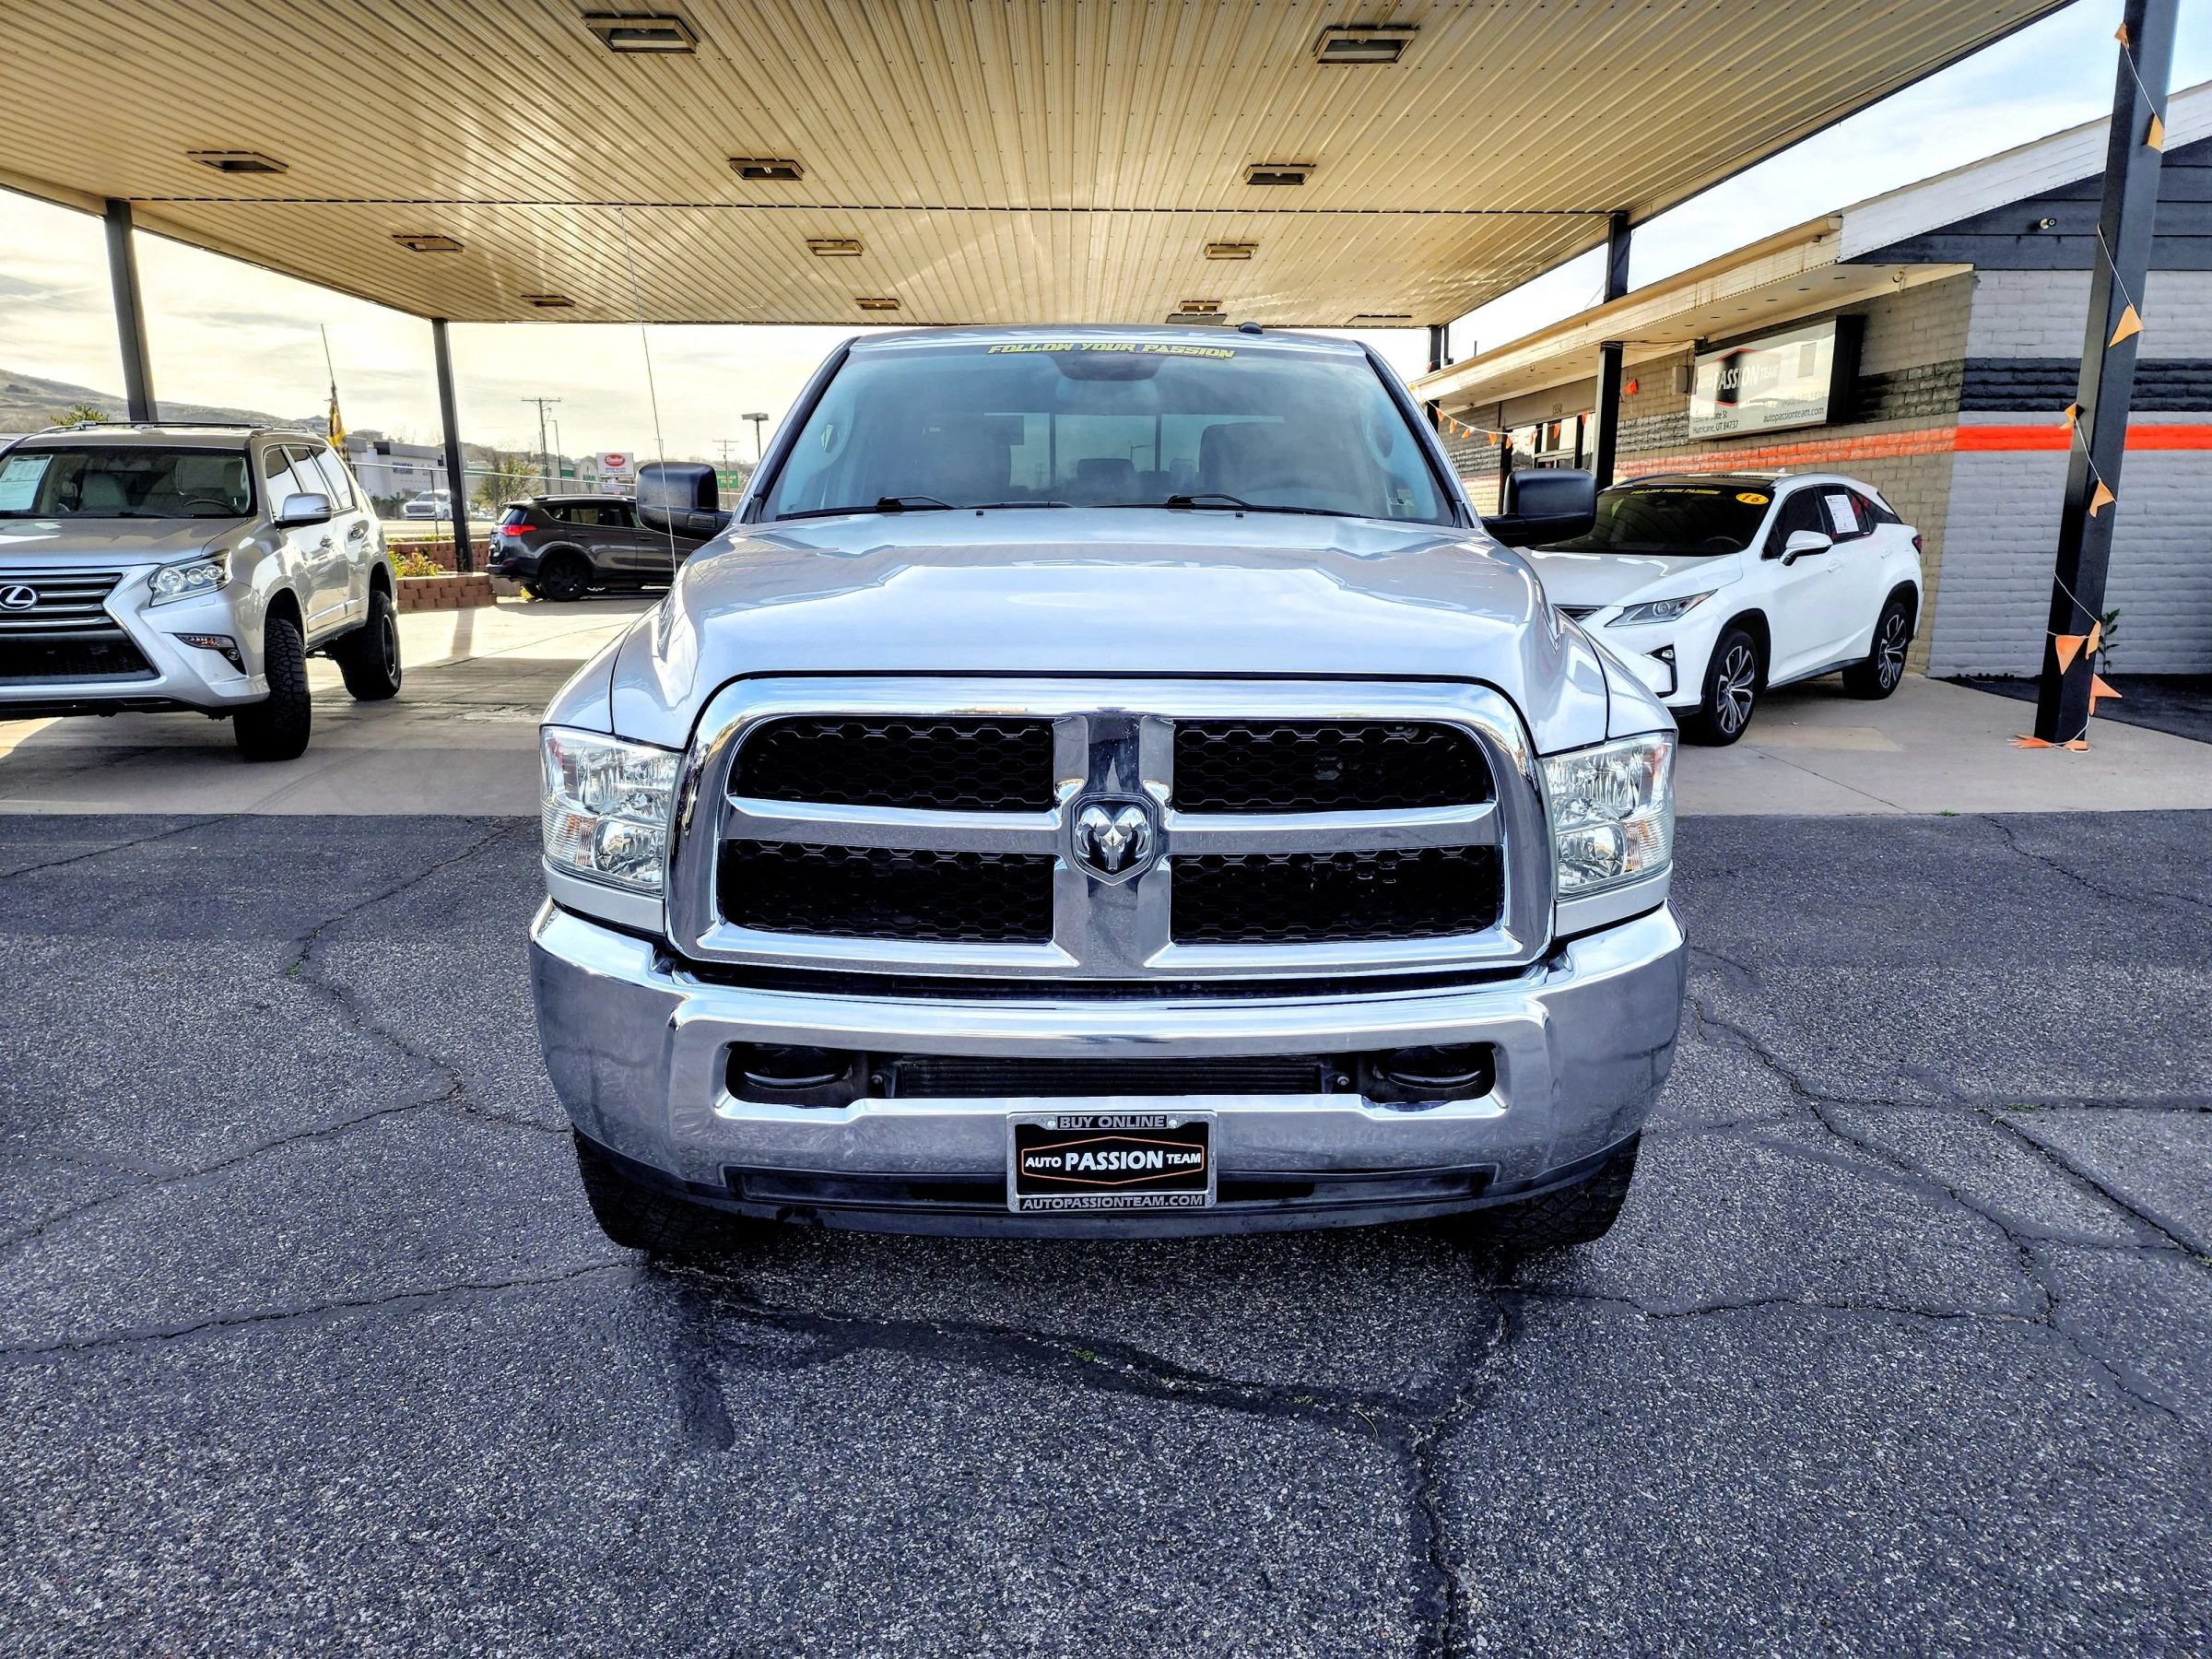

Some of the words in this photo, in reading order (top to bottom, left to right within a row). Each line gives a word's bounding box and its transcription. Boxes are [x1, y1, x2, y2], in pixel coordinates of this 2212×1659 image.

[988, 343, 1074, 354] FOLLOW
[1079, 343, 1135, 352] YOUR
[1142, 344, 1236, 359] PASSION
[1762, 407, 1824, 423] autopassionteam.com
[1715, 421, 1723, 430] UT
[1724, 419, 1739, 429] 84737
[1742, 494, 1759, 503] 16
[1059, 1116, 1093, 1129] BUY
[1098, 1115, 1165, 1129] ONLINE
[1025, 1156, 1062, 1168] AUTO
[1065, 1150, 1163, 1171] PASSION
[1166, 1152, 1202, 1164] TEAM
[1021, 1194, 1204, 1211] AUTOPASSIONTEAM.COM
